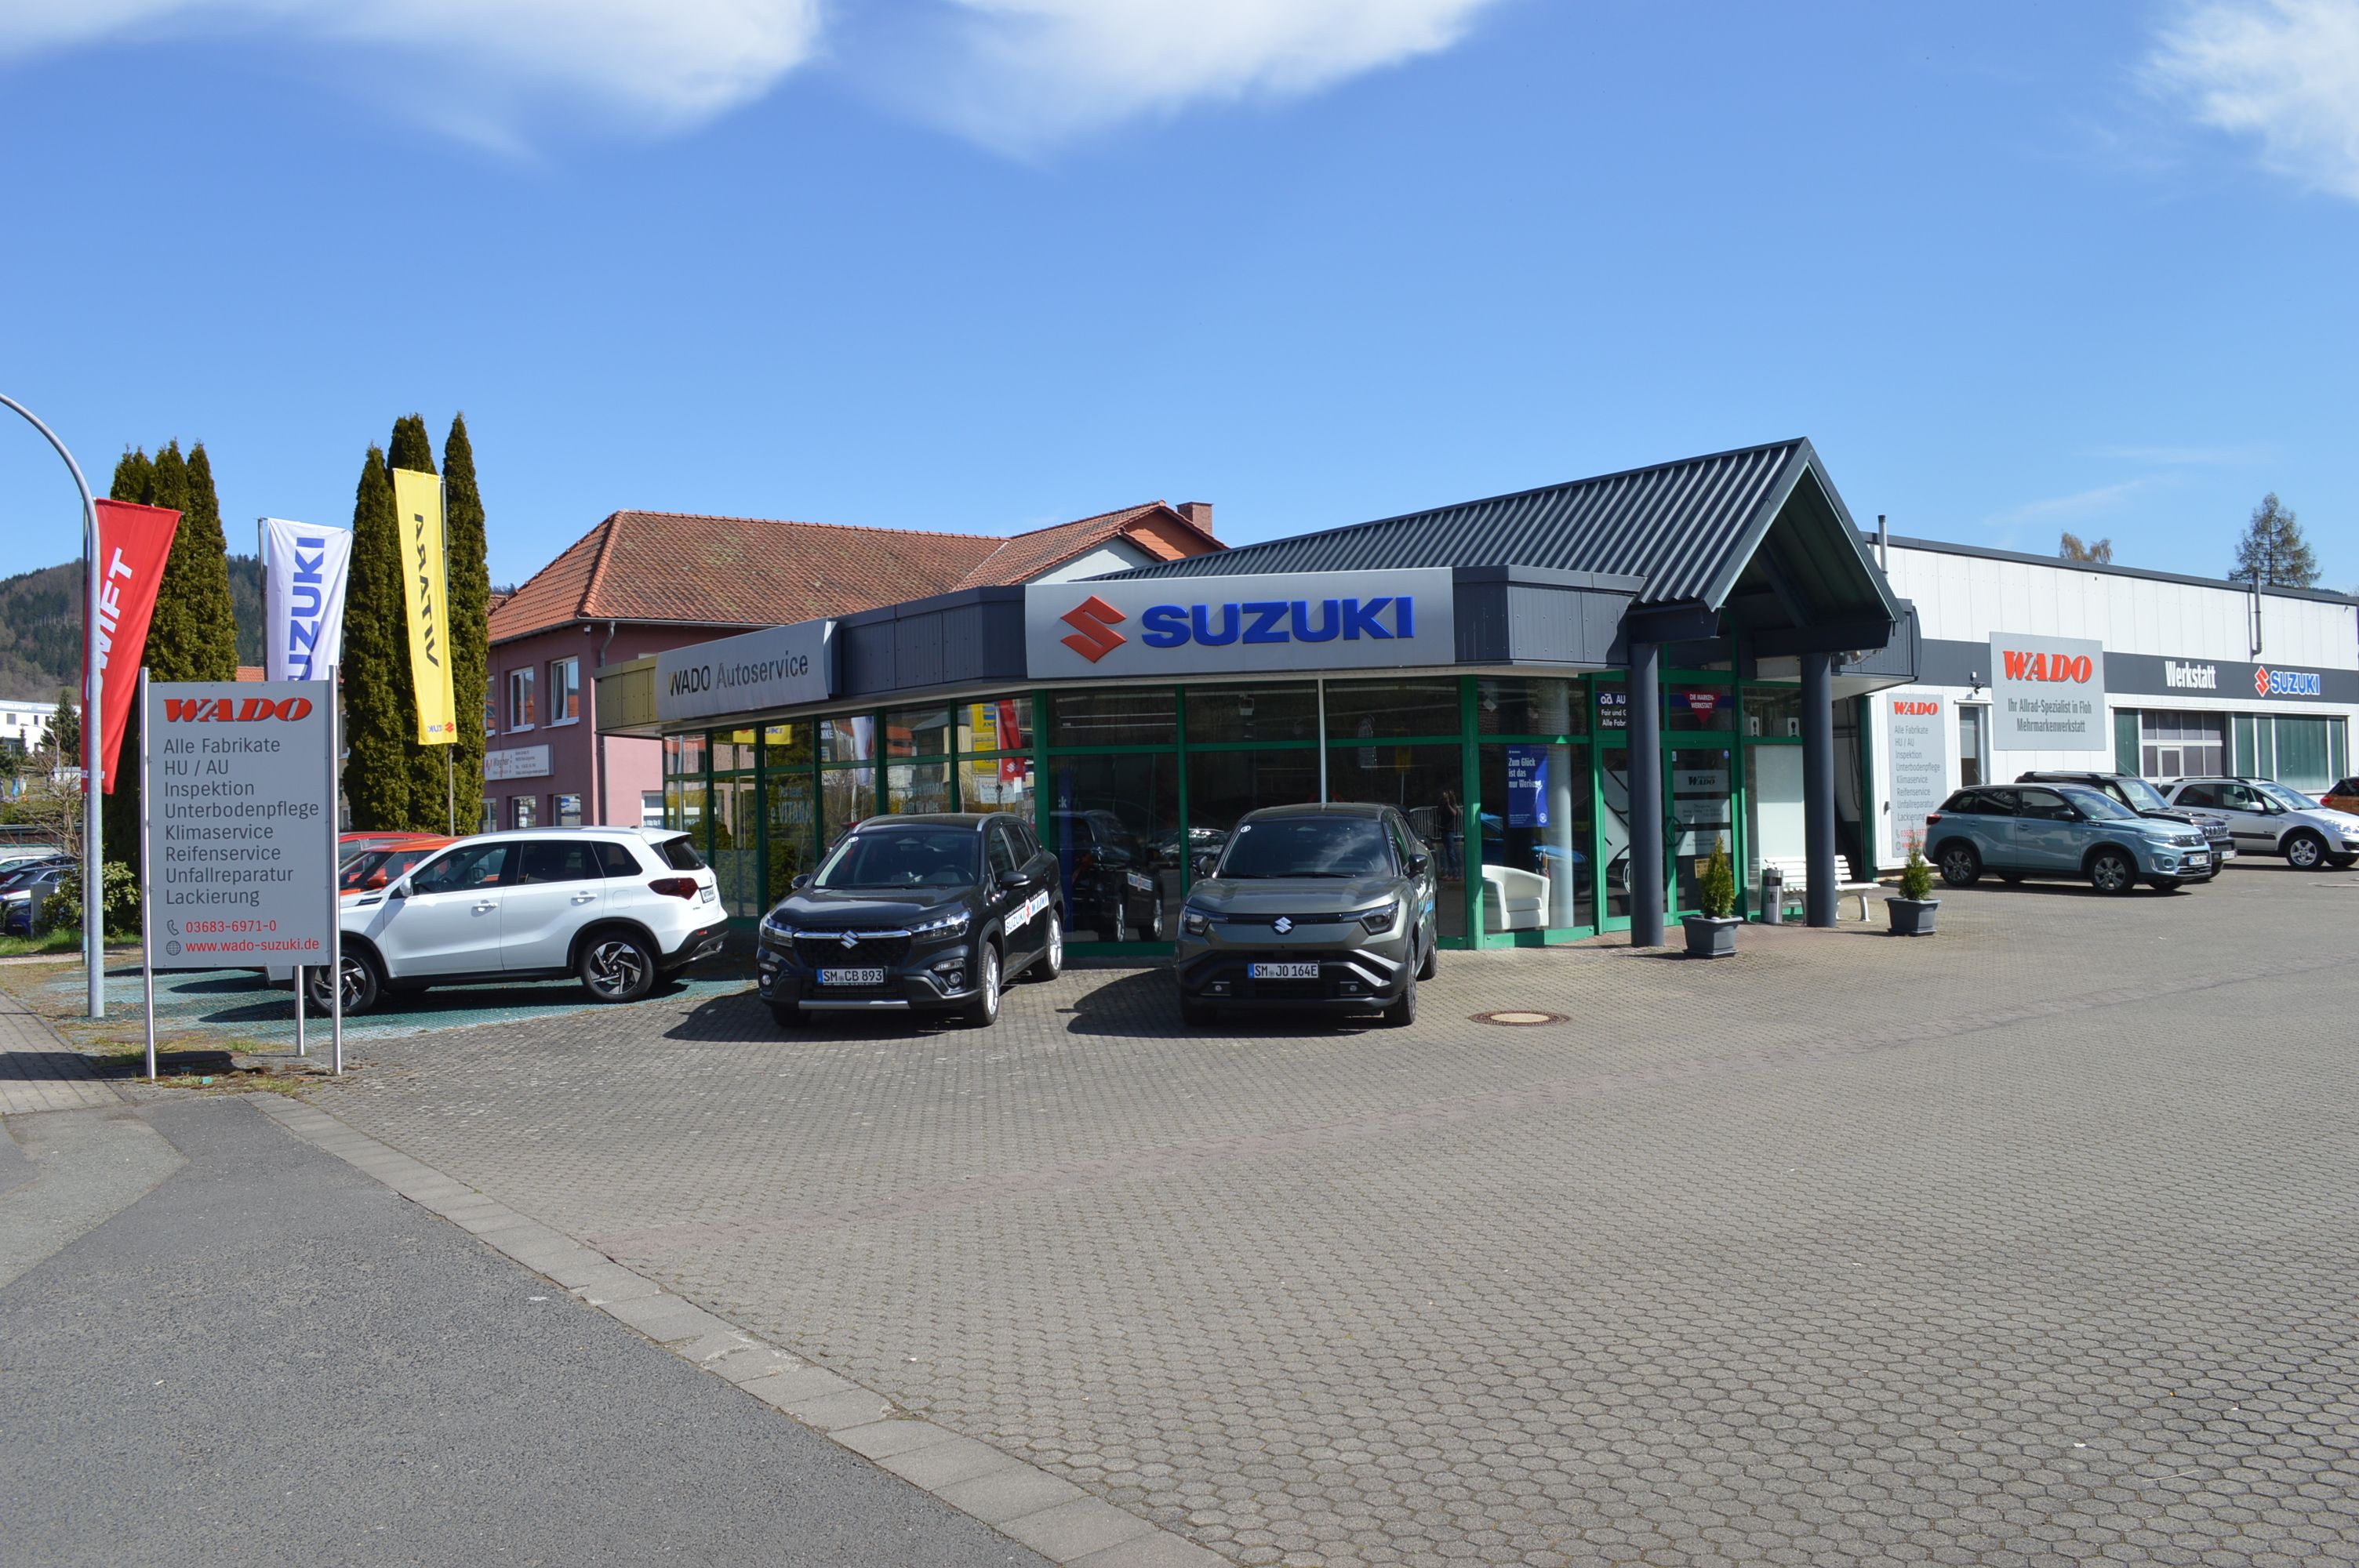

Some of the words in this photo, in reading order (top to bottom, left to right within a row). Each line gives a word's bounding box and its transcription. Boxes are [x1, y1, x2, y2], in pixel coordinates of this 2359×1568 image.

[287, 537, 325, 681] UZUKI
[86, 547, 133, 701] WIFT
[1142, 596, 1415, 648] SUZUKI
[669, 666, 711, 697] WADO
[716, 650, 809, 690] Autoservice
[2003, 651, 2093, 684] WADO
[2165, 661, 2216, 689] Werkstatt
[2270, 670, 2321, 695] SUZUKI
[1616, 695, 1627, 705] AU
[1894, 701, 1939, 715] WADO
[2008, 698, 2018, 712] Ihr
[2019, 698, 2071, 715] Allrad-Spezialist
[2072, 700, 2078, 713] in
[2079, 700, 2092, 714] Floh
[164, 697, 313, 722] WADO
[1895, 725, 1904, 734] Alle
[1906, 725, 1928, 734] Fabrikate
[2016, 717, 2086, 732] Mehrmarkenwerkstatt
[163, 739, 195, 754] Alle
[202, 737, 281, 753] Fabrikate
[1895, 738, 1903, 746] HU
[1907, 738, 1914, 746] AU
[1509, 757, 1520, 766] Zum
[1896, 750, 1922, 760] Inspektion
[165, 760, 188, 776] HU
[194, 760, 201, 776] /
[206, 759, 229, 775] AU
[1517, 768, 1526, 778] das
[1896, 763, 1941, 772] Unterbodenpflege
[1896, 775, 1928, 784] Klimaservice
[165, 781, 255, 800] Inspektion
[1897, 788, 1931, 797] Reifenservice
[165, 800, 319, 820] Unterbodenpflege
[778, 800, 813, 824] VITARA
[1897, 800, 1935, 809] Unfallreparatur
[1898, 811, 1925, 822] Lackierung
[165, 824, 274, 840] Klimaservice
[165, 845, 282, 862] Reifenservice
[166, 867, 294, 885] Unfallreparatur
[166, 889, 260, 907] Lackierung
[186, 920, 277, 933] 03683-6971-0
[185, 938, 320, 953] www.wado-suzuki.de
[823, 971, 838, 982] SM
[845, 971, 860, 982] CB
[862, 971, 882, 982] 893
[1255, 965, 1268, 977] SM
[1292, 965, 1318, 977] 164E
